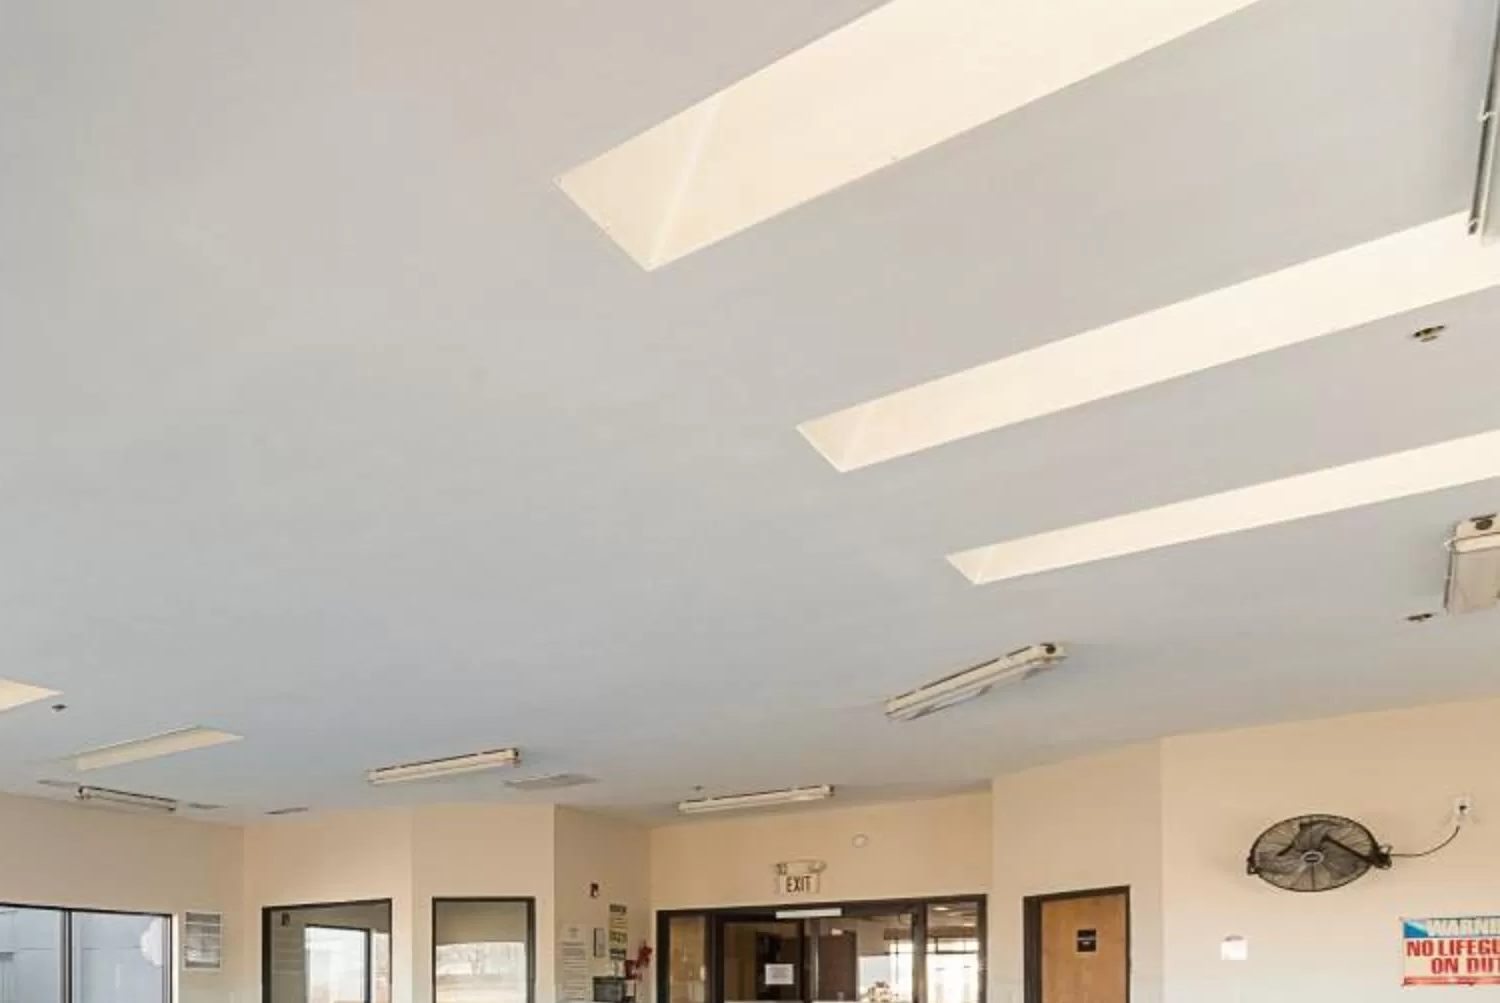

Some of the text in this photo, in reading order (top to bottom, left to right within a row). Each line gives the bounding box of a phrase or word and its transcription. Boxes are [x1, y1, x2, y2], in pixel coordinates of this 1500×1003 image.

[786, 875, 811, 893] EXIT
[1427, 918, 1500, 935] WARNI
[1407, 940, 1433, 957] NO
[1431, 957, 1458, 974] ON
